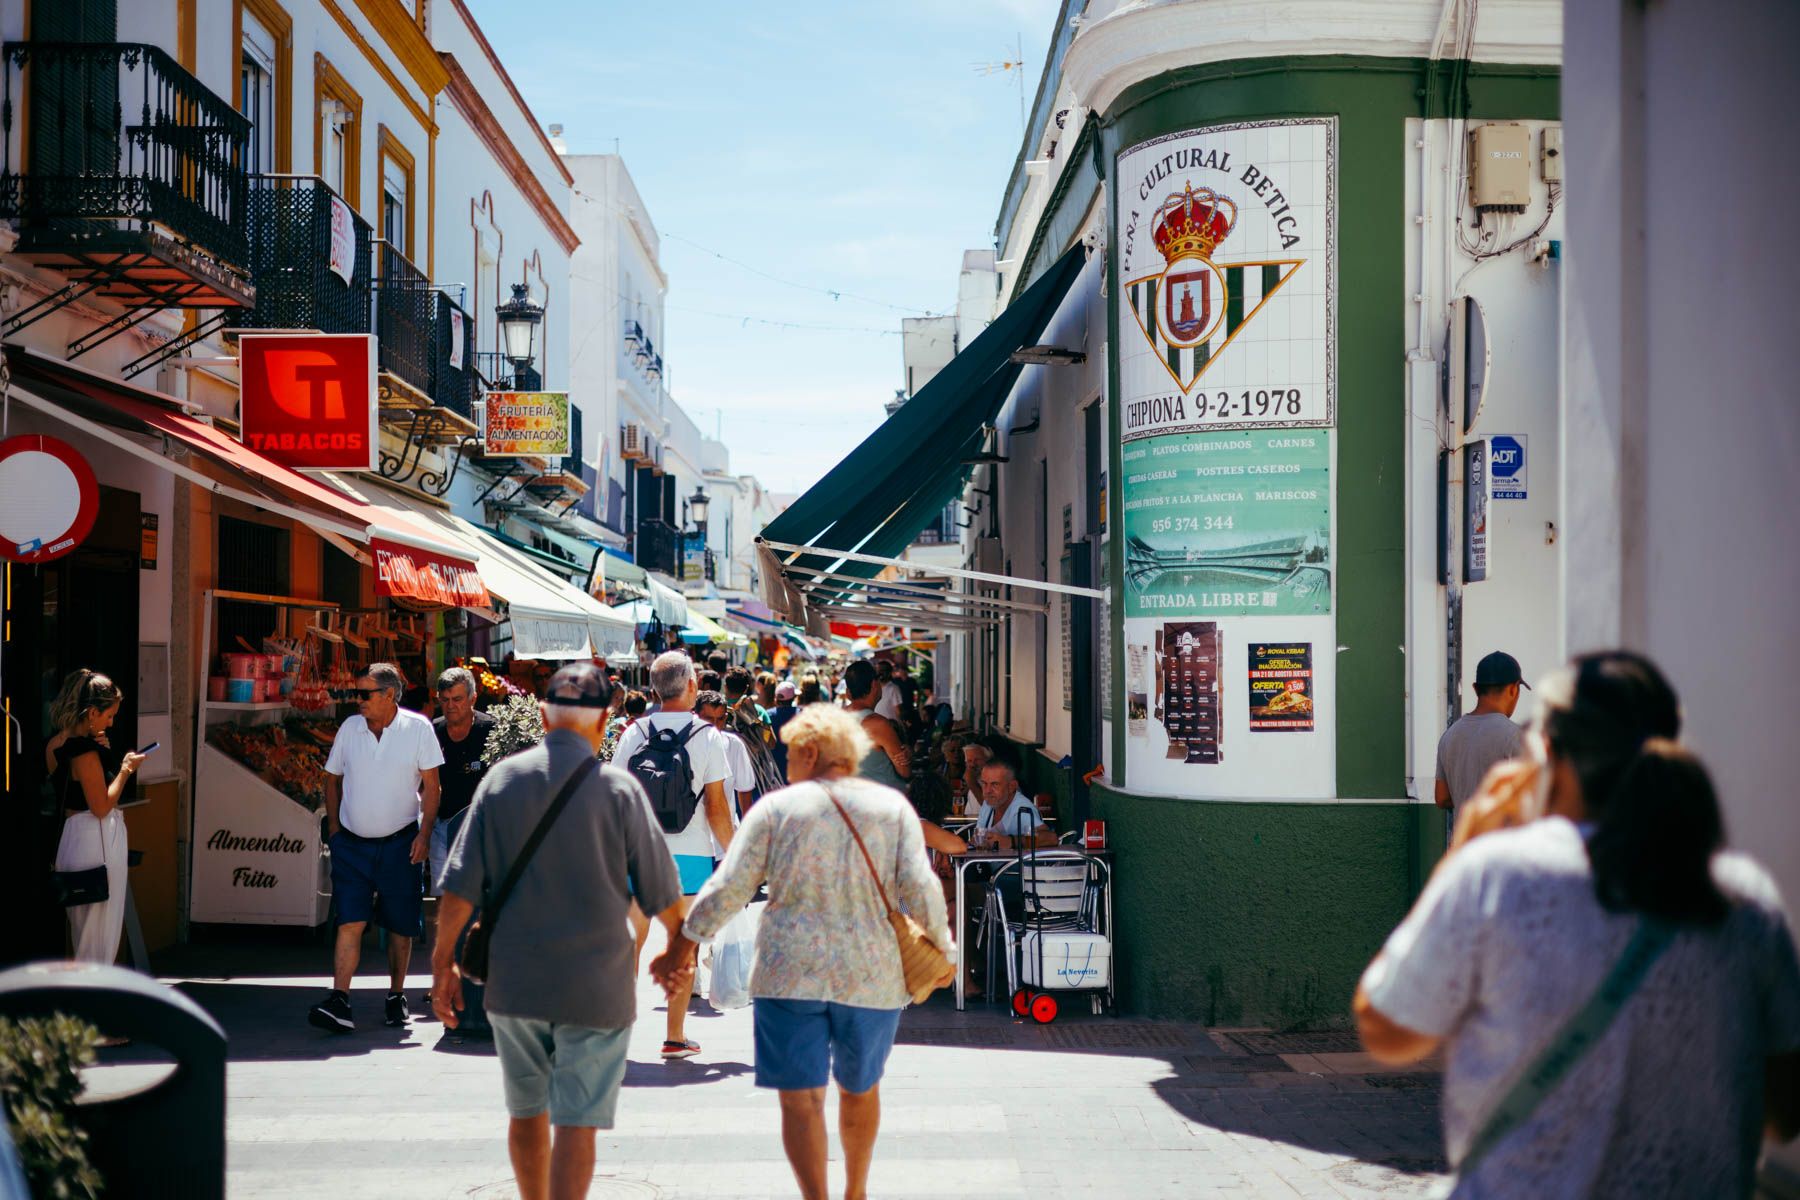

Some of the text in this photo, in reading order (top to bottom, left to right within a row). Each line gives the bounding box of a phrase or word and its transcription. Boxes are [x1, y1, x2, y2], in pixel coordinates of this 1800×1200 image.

[1124, 148, 1301, 272] PEÑA CULTURAL BETICA
[500, 405, 554, 416] FRUTERÍA
[1127, 389, 1302, 429] CHIPIONA 9-2-1978
[249, 432, 363, 450] TABACOS
[491, 429, 564, 440] ALIMENTACIÓN
[1152, 445, 1180, 456] PLATOS
[1181, 440, 1252, 453] COMBINADOS
[1267, 438, 1315, 448] CARNES
[1492, 450, 1517, 463] ADT
[1147, 469, 1177, 481] CASERAS
[1196, 466, 1244, 476] POSTRES
[1247, 464, 1300, 474] CASEROS
[1171, 495, 1178, 504] A
[1180, 495, 1191, 504] LA
[1193, 492, 1244, 503] PLANCHA
[1255, 490, 1318, 501] MARISCOS
[1152, 515, 1234, 533] 956 374 344
[1139, 593, 1197, 609] ENTRADA
[1202, 592, 1260, 607] LIBRE
[1252, 681, 1285, 690] OFERTA
[207, 829, 306, 853] Almendra
[232, 867, 279, 888] Frita
[1057, 968, 1067, 976] La
